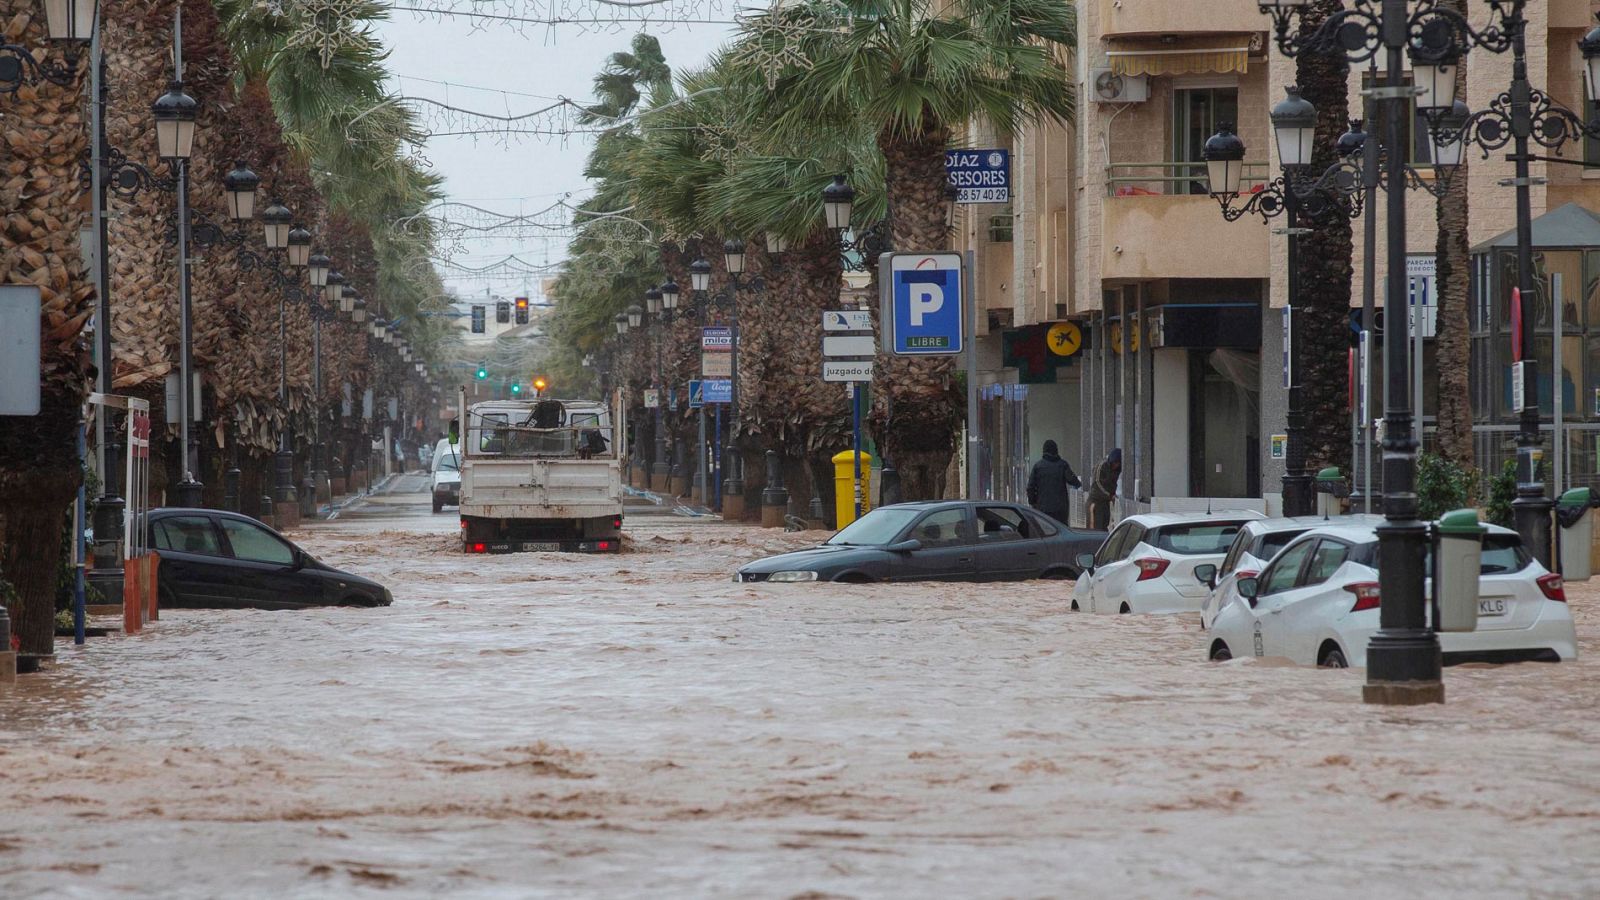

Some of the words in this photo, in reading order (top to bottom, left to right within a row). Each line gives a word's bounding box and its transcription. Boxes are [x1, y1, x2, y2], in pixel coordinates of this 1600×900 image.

[944, 152, 979, 167] DÍAZ
[947, 170, 1005, 186] SESORES
[971, 189, 980, 200] 57
[983, 189, 993, 200] 40
[996, 189, 1006, 200] 29
[910, 282, 944, 326] P
[911, 338, 942, 346] LIBRE
[827, 368, 862, 376] juzgado
[1480, 600, 1504, 612] KLG
